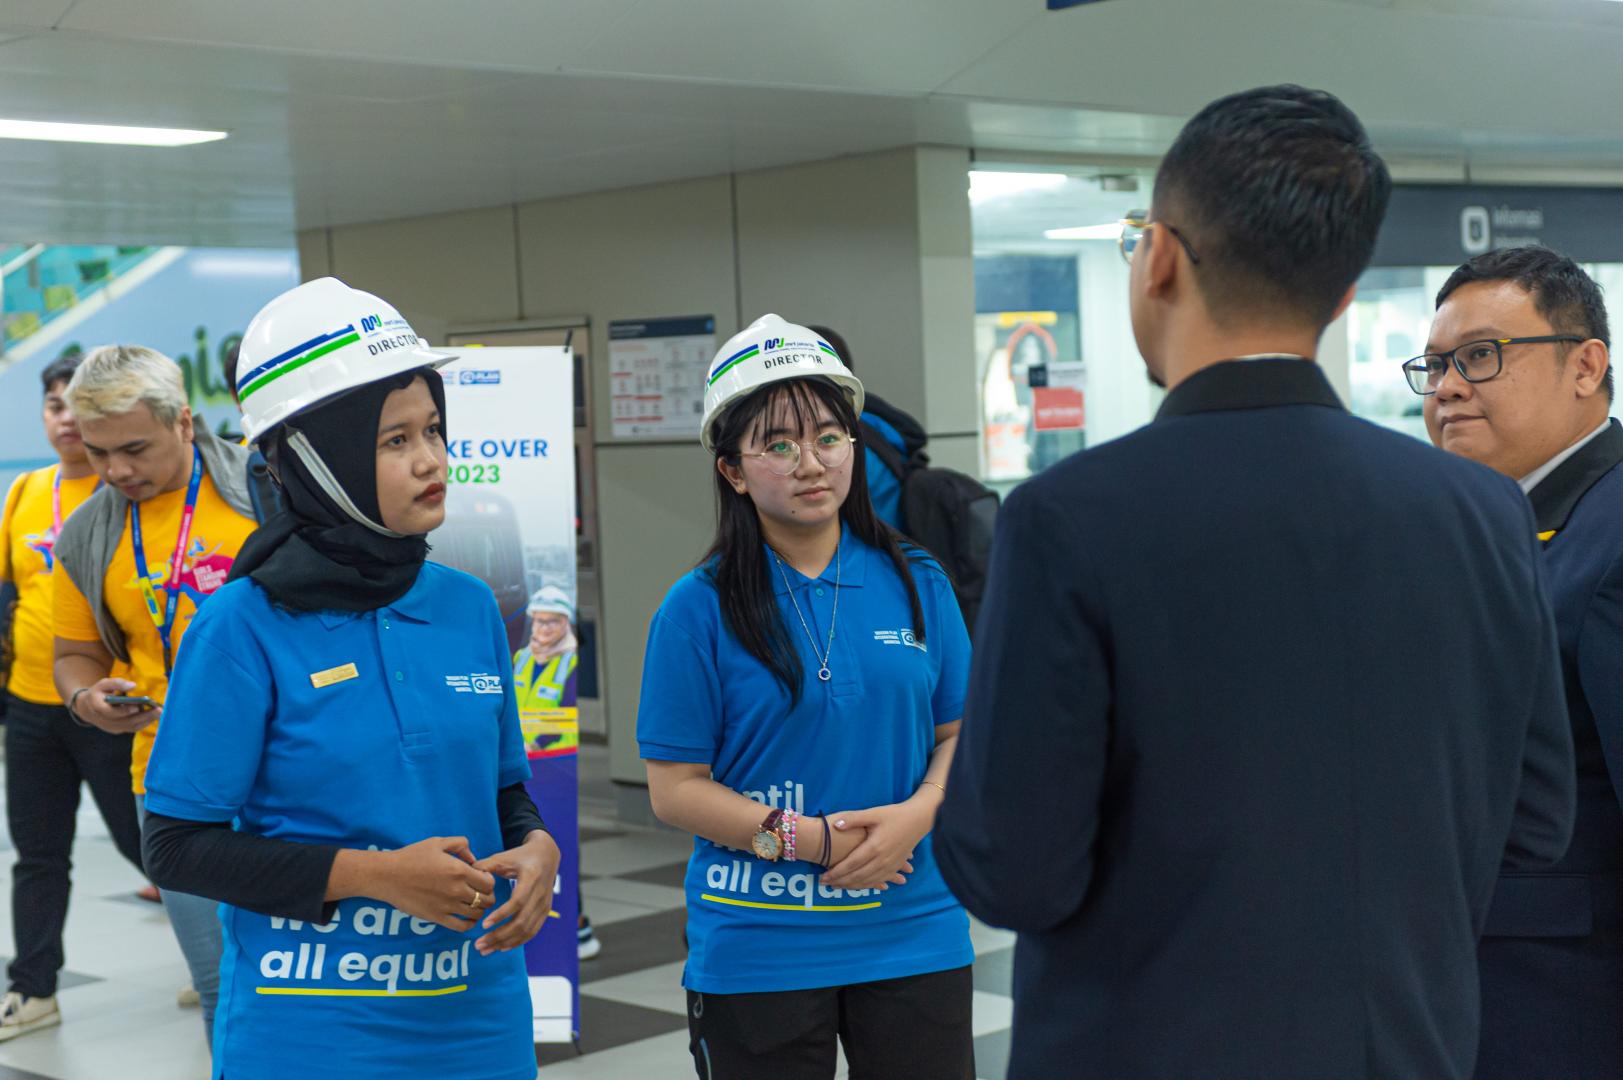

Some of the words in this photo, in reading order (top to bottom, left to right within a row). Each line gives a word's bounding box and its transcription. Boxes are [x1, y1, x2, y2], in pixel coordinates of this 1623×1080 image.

[447, 440, 472, 458] KE
[480, 440, 548, 458] OVER
[446, 464, 500, 483] 2023
[743, 780, 804, 815] ntil
[706, 860, 752, 894] all
[353, 906, 436, 936] are
[260, 943, 326, 980] all
[338, 940, 471, 994] equal
